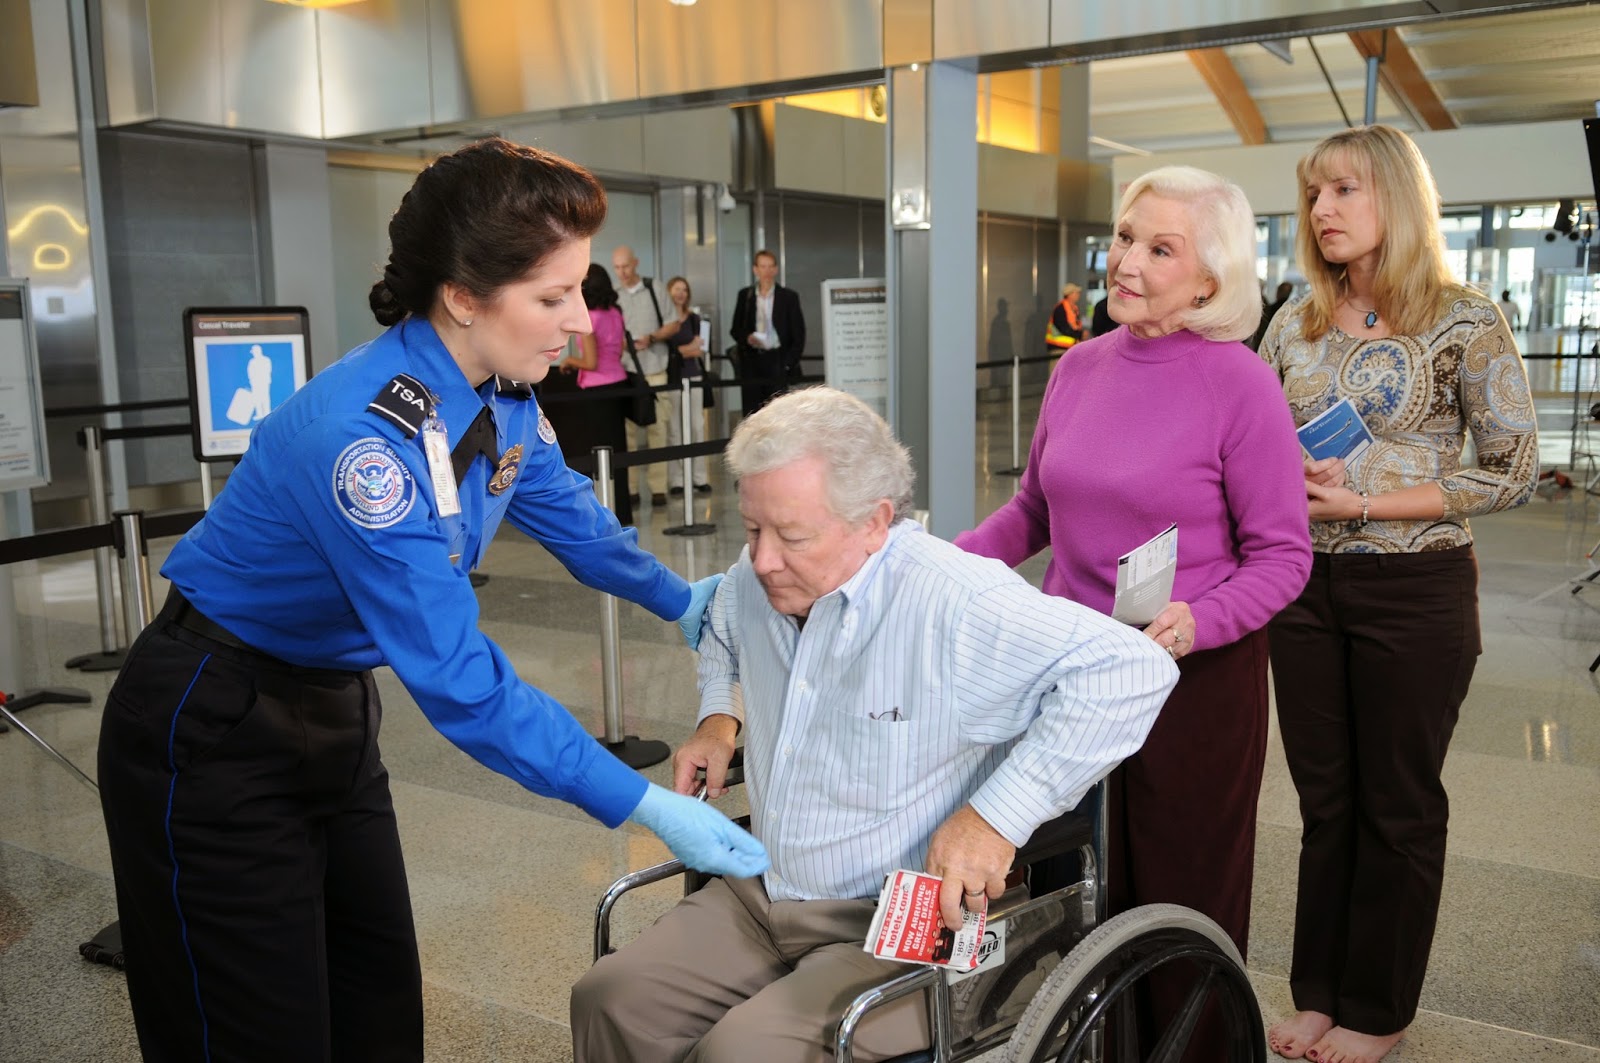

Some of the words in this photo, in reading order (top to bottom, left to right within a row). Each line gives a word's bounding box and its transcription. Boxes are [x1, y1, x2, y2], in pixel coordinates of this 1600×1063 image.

[198, 321, 221, 330] Casual
[222, 320, 250, 329] Traveler
[391, 380, 425, 411] TSA
[338, 443, 385, 491] TRANSPORTATION
[385, 447, 411, 481] SECURITY
[348, 499, 409, 523] ADMINISTRATION
[349, 490, 380, 511] HOMELAND
[382, 483, 402, 510] SECURITY
[886, 889, 909, 949] hotels.com
[903, 931, 915, 953] NOW
[912, 881, 927, 930] ARRIVING:
[912, 920, 926, 950] GREAT
[922, 889, 932, 920] DEALS
[923, 920, 931, 936] FROM
